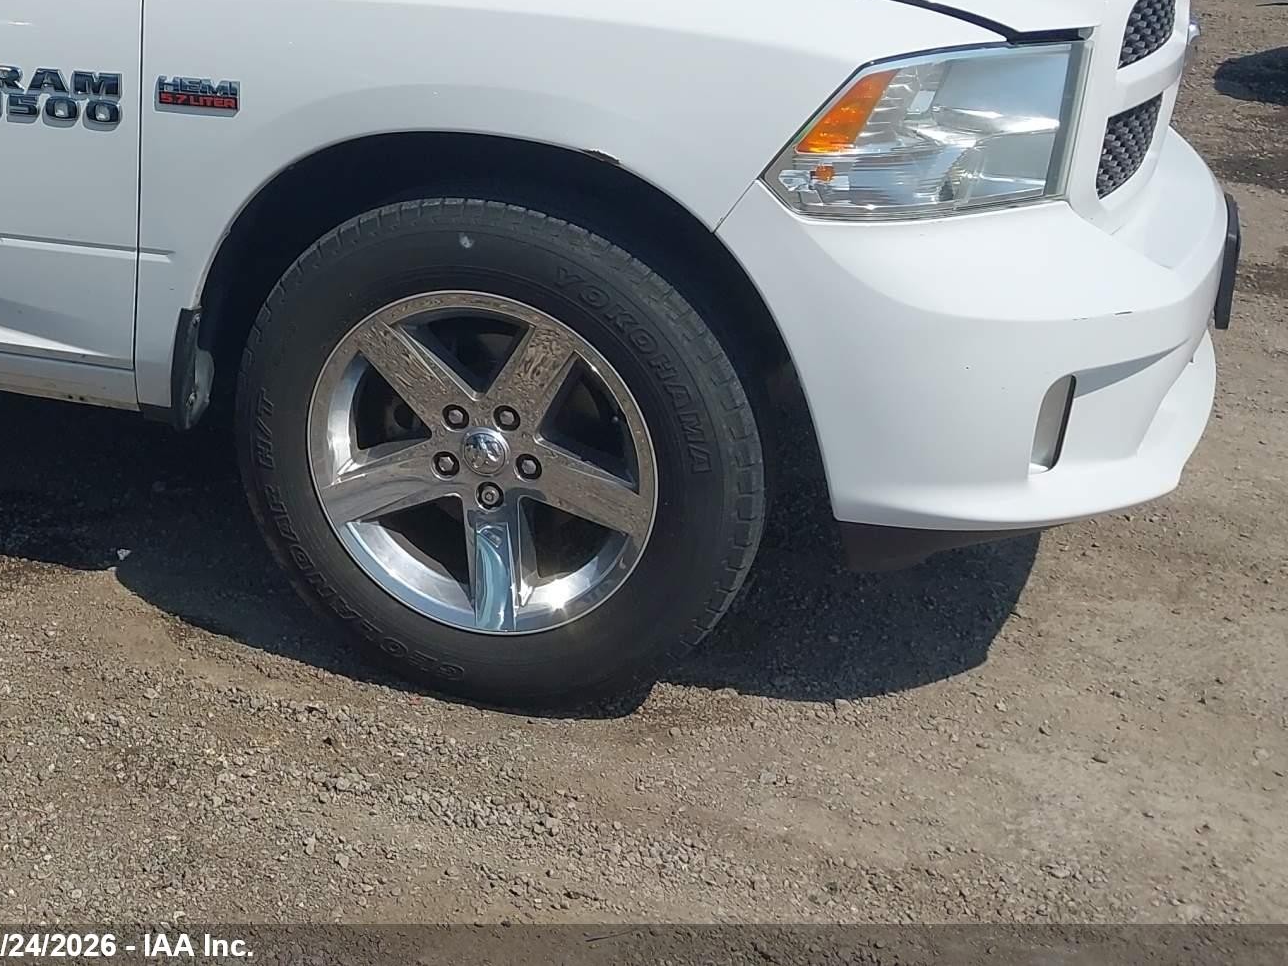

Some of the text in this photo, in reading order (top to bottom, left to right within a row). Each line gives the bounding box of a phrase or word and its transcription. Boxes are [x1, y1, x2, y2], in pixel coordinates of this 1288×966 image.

[158, 75, 241, 96] HEMI
[159, 92, 238, 109] 5.7 LITER
[556, 264, 713, 475] YOKOHAMA
